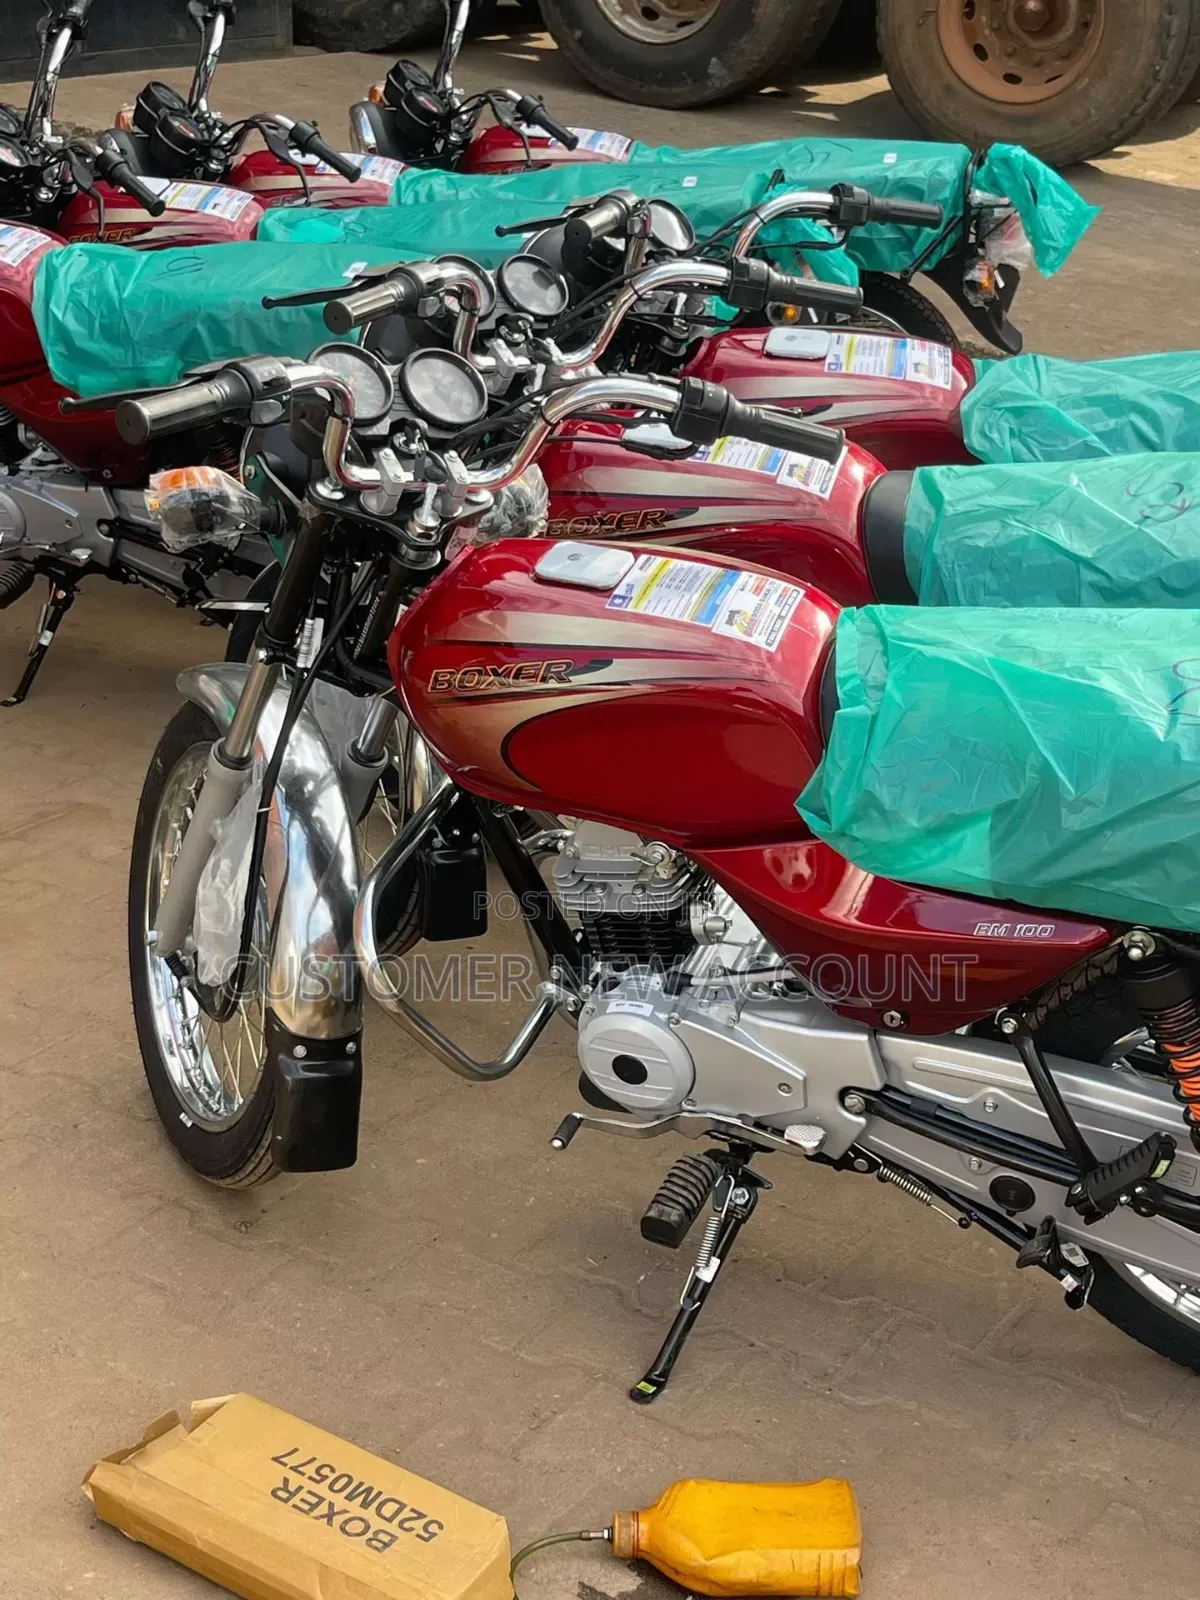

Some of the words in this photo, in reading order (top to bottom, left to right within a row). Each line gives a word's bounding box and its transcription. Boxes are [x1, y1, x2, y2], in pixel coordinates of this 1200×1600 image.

[544, 508, 668, 538] BOXER
[428, 659, 575, 693] BOXER
[973, 922, 1011, 937] BM
[1013, 923, 1056, 938] 100
[270, 1446, 445, 1543] 52DM0577
[270, 1476, 400, 1553] BOXER
